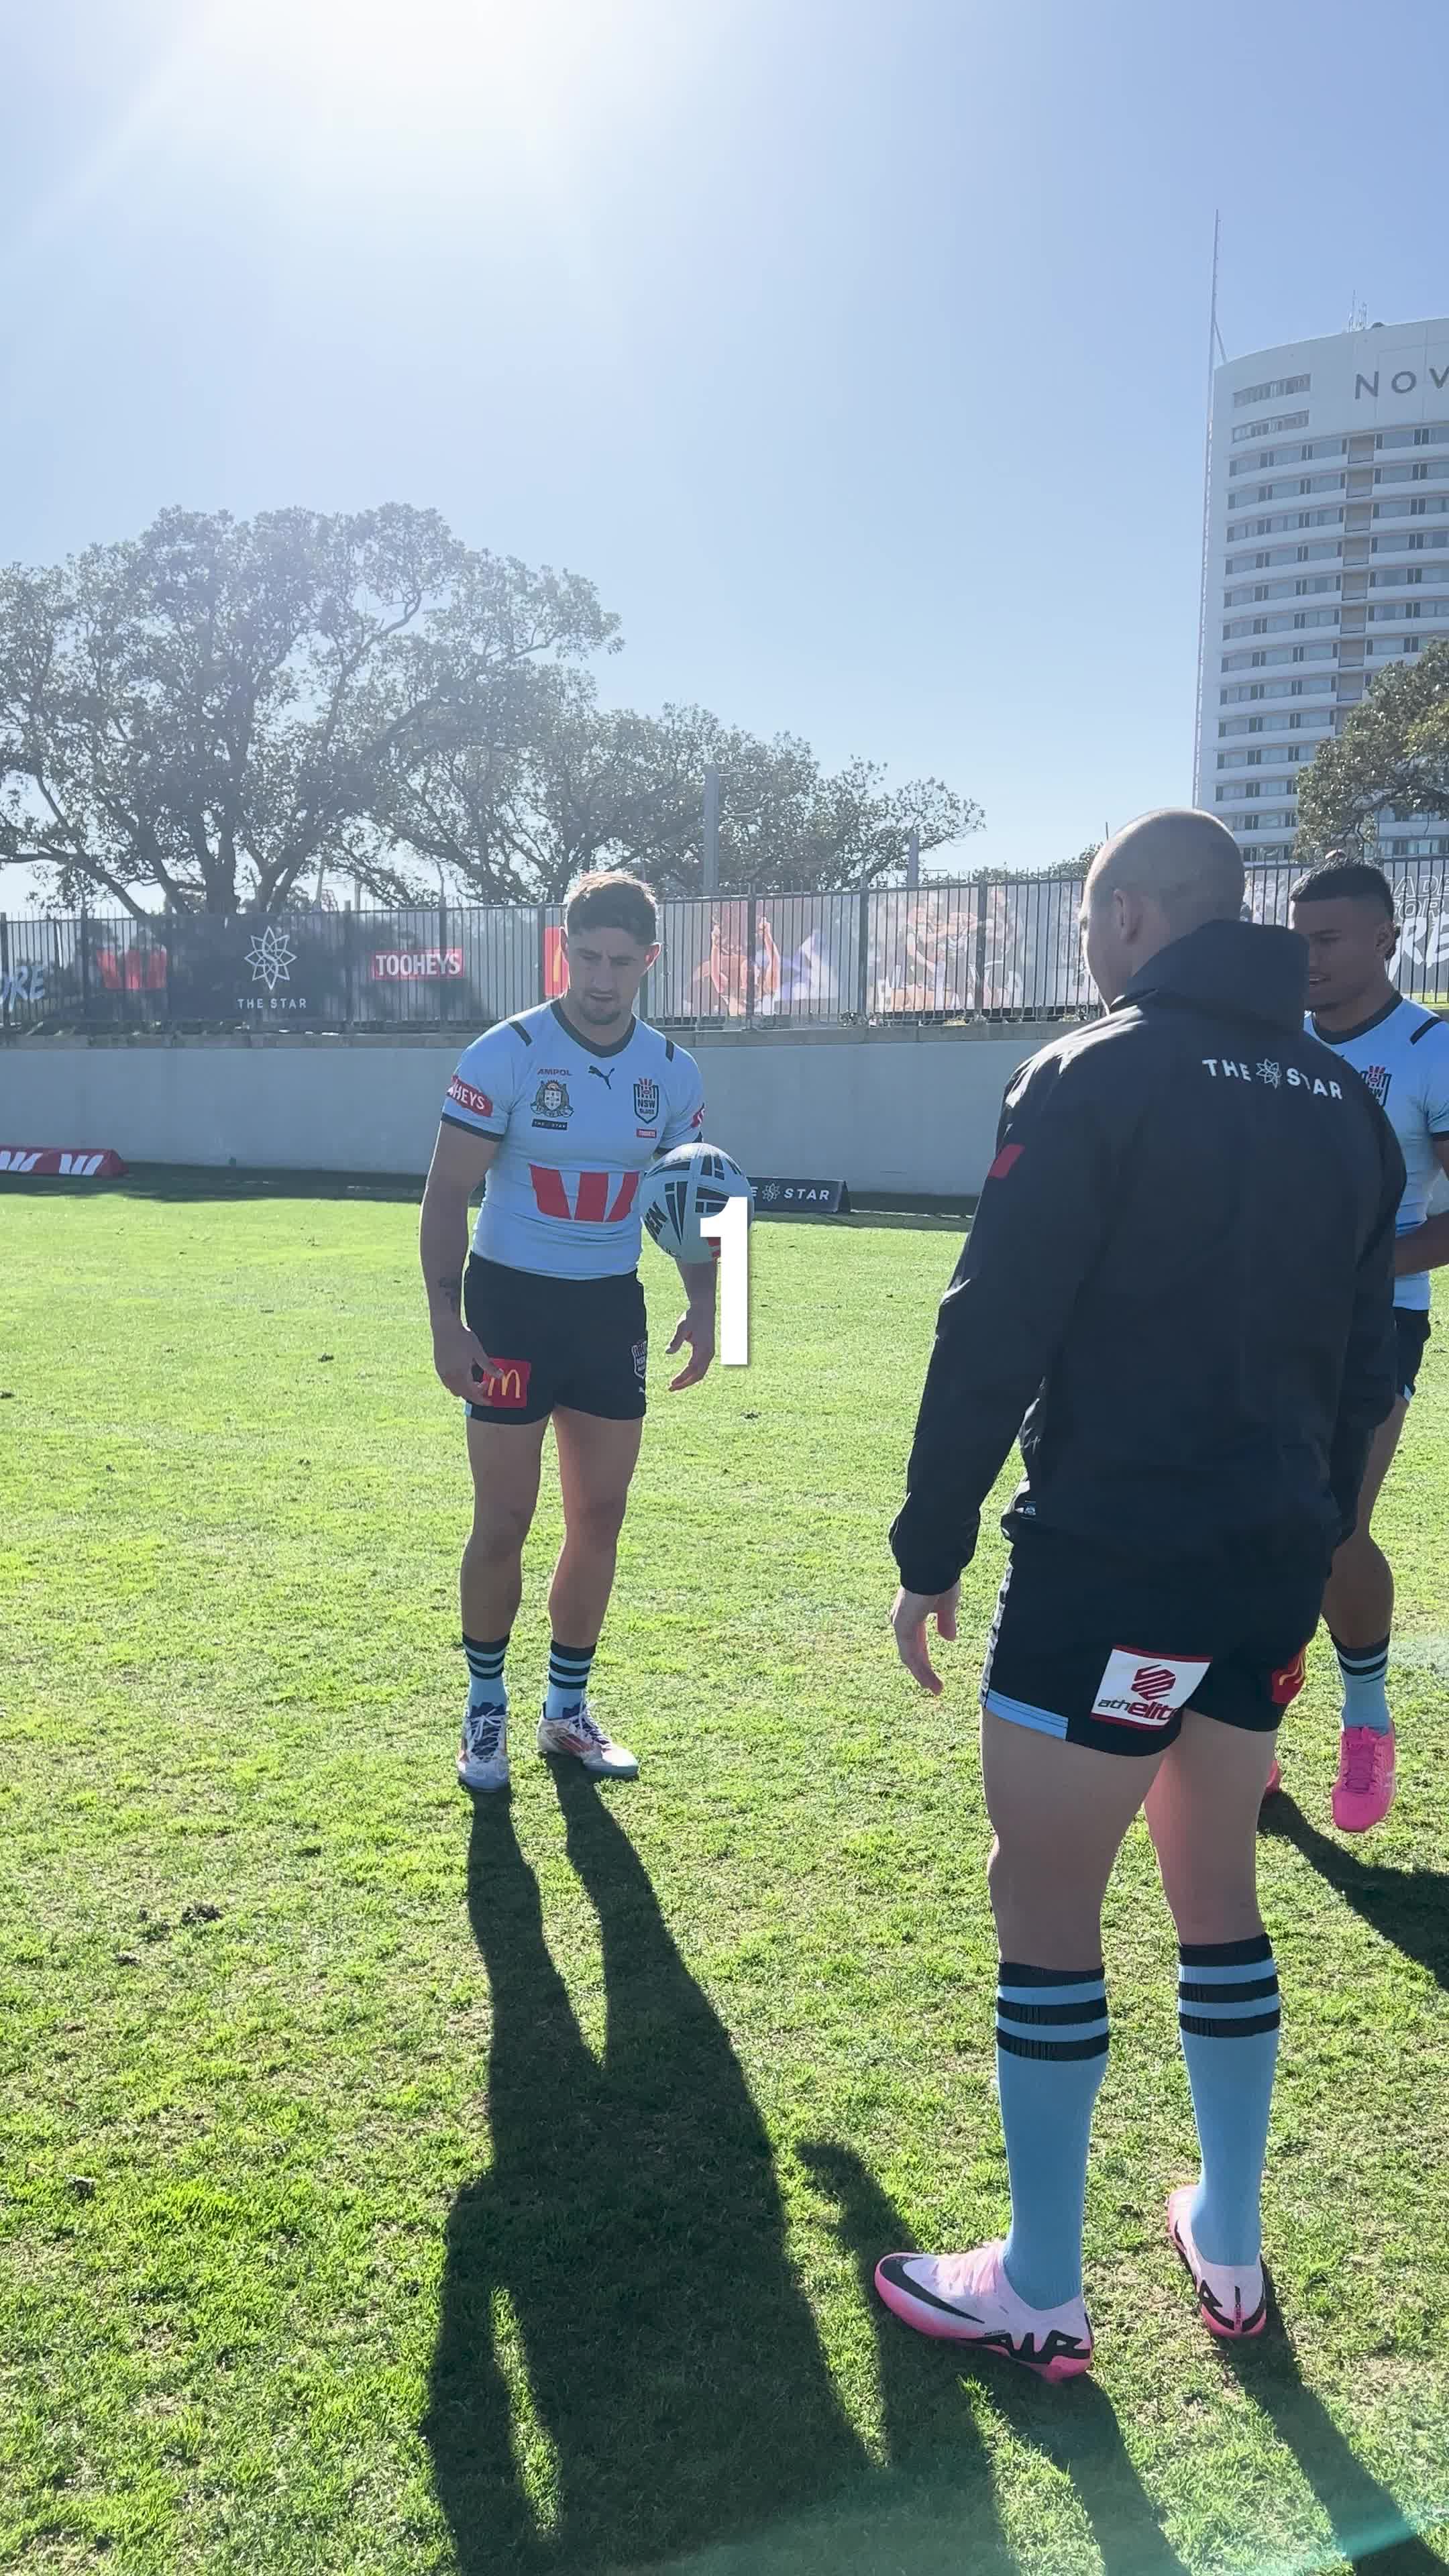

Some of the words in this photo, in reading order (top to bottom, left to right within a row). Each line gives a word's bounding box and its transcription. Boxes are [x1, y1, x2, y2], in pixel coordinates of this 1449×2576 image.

[1354, 366, 1449, 400] NOV
[1385, 875, 1449, 898] ADE
[1393, 898, 1444, 922] OR
[1387, 912, 1449, 983] RE
[376, 954, 461, 976] TOOHEYS
[237, 998, 264, 1009] THE
[270, 998, 307, 1009] STAR
[537, 1068, 573, 1076] AMPOL
[1202, 1059, 1251, 1081] THE
[445, 1079, 484, 1110] HEYS
[637, 1099, 655, 1109] NSW
[784, 1187, 830, 1201] STAR
